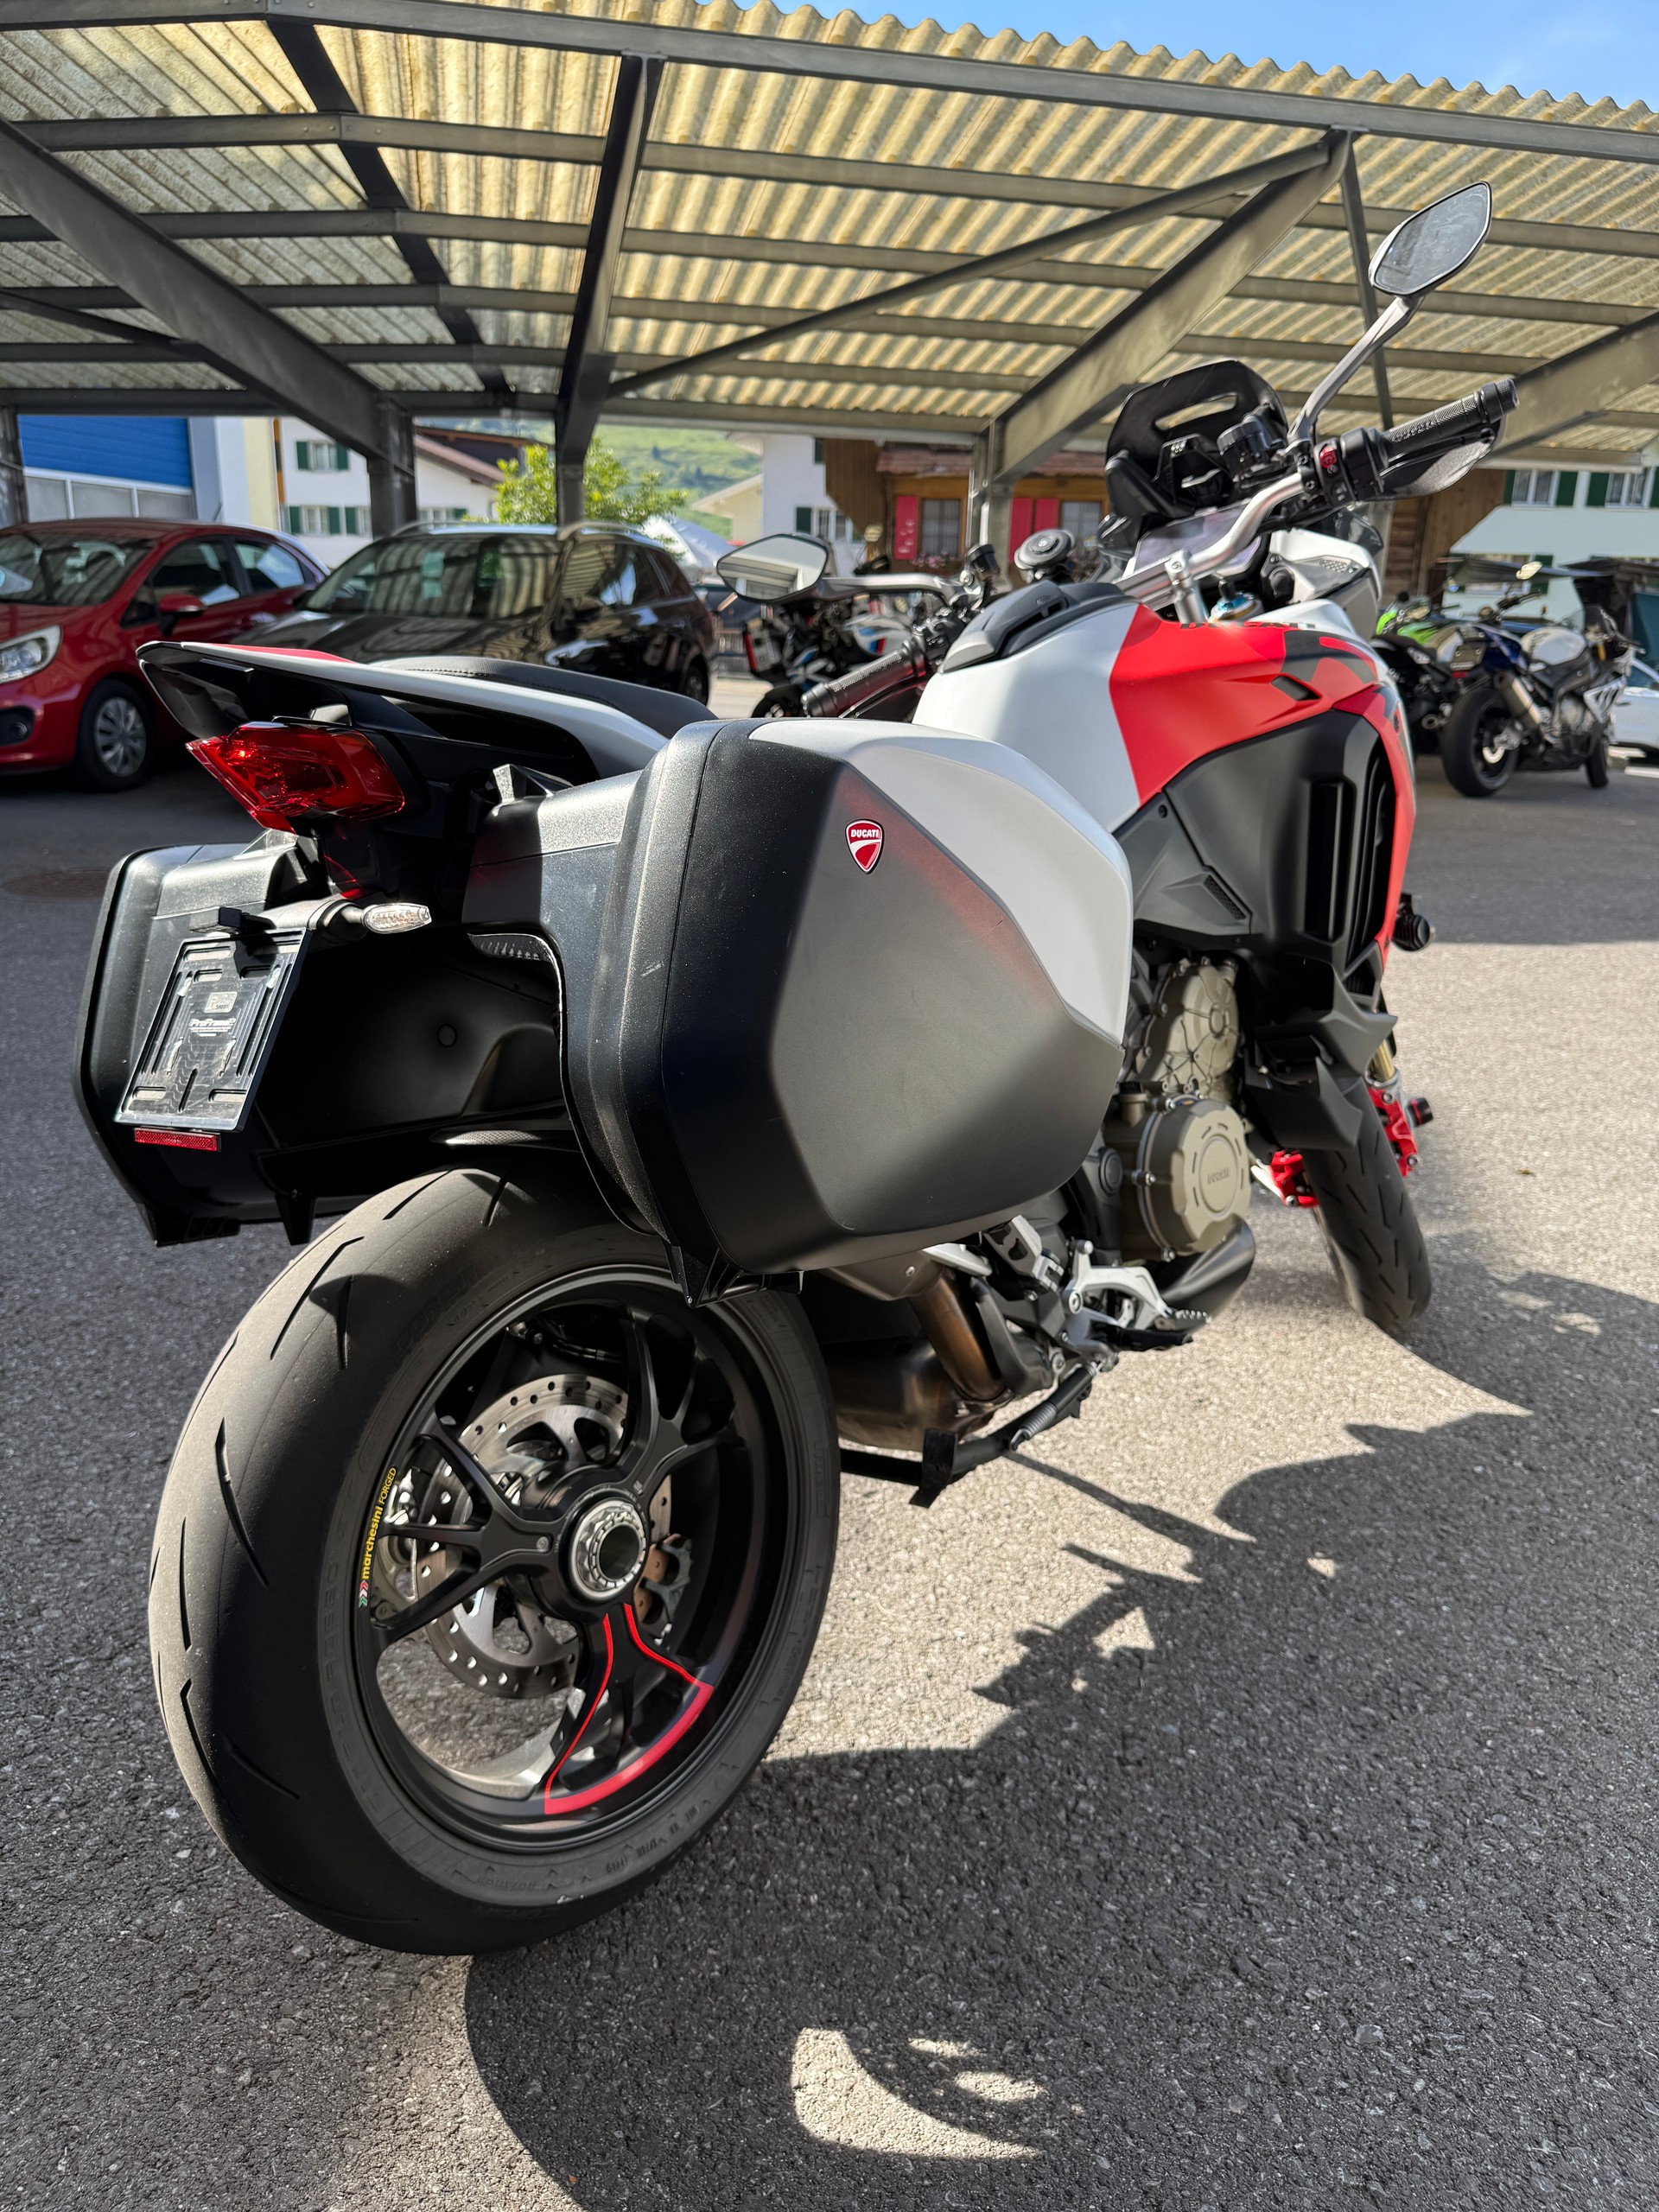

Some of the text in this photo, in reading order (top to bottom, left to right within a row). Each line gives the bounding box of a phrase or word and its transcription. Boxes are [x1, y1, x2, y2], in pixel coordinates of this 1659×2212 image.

[850, 829, 880, 838] DUCATI
[361, 1467, 397, 1580] marchesini FORGED
